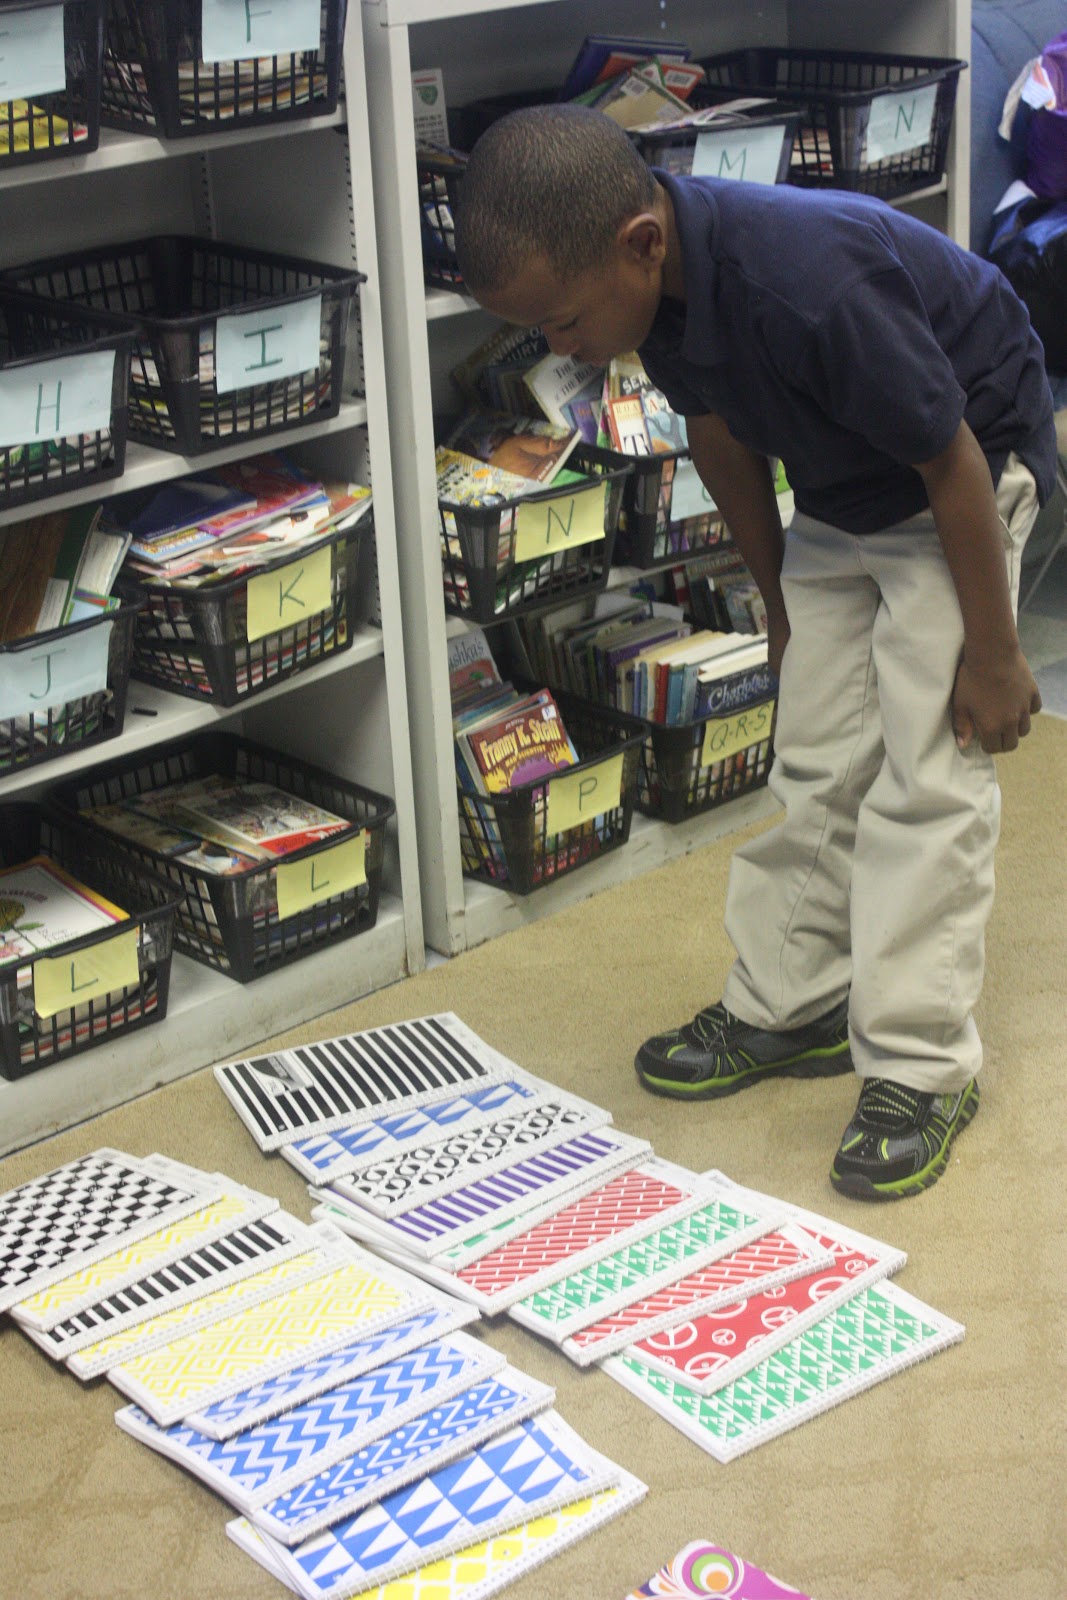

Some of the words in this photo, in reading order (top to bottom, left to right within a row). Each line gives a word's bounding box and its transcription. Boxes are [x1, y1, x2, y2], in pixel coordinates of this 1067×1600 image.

[894, 98, 918, 141] N
[718, 147, 748, 182] M
[243, 324, 283, 372] I
[35, 380, 62, 434] H
[546, 499, 575, 545] N
[279, 569, 306, 617] K
[30, 648, 67, 698] J
[479, 731, 519, 770] Franny
[529, 718, 562, 744] Stein
[579, 776, 598, 811] P
[311, 861, 330, 892] L
[71, 961, 99, 993] L
